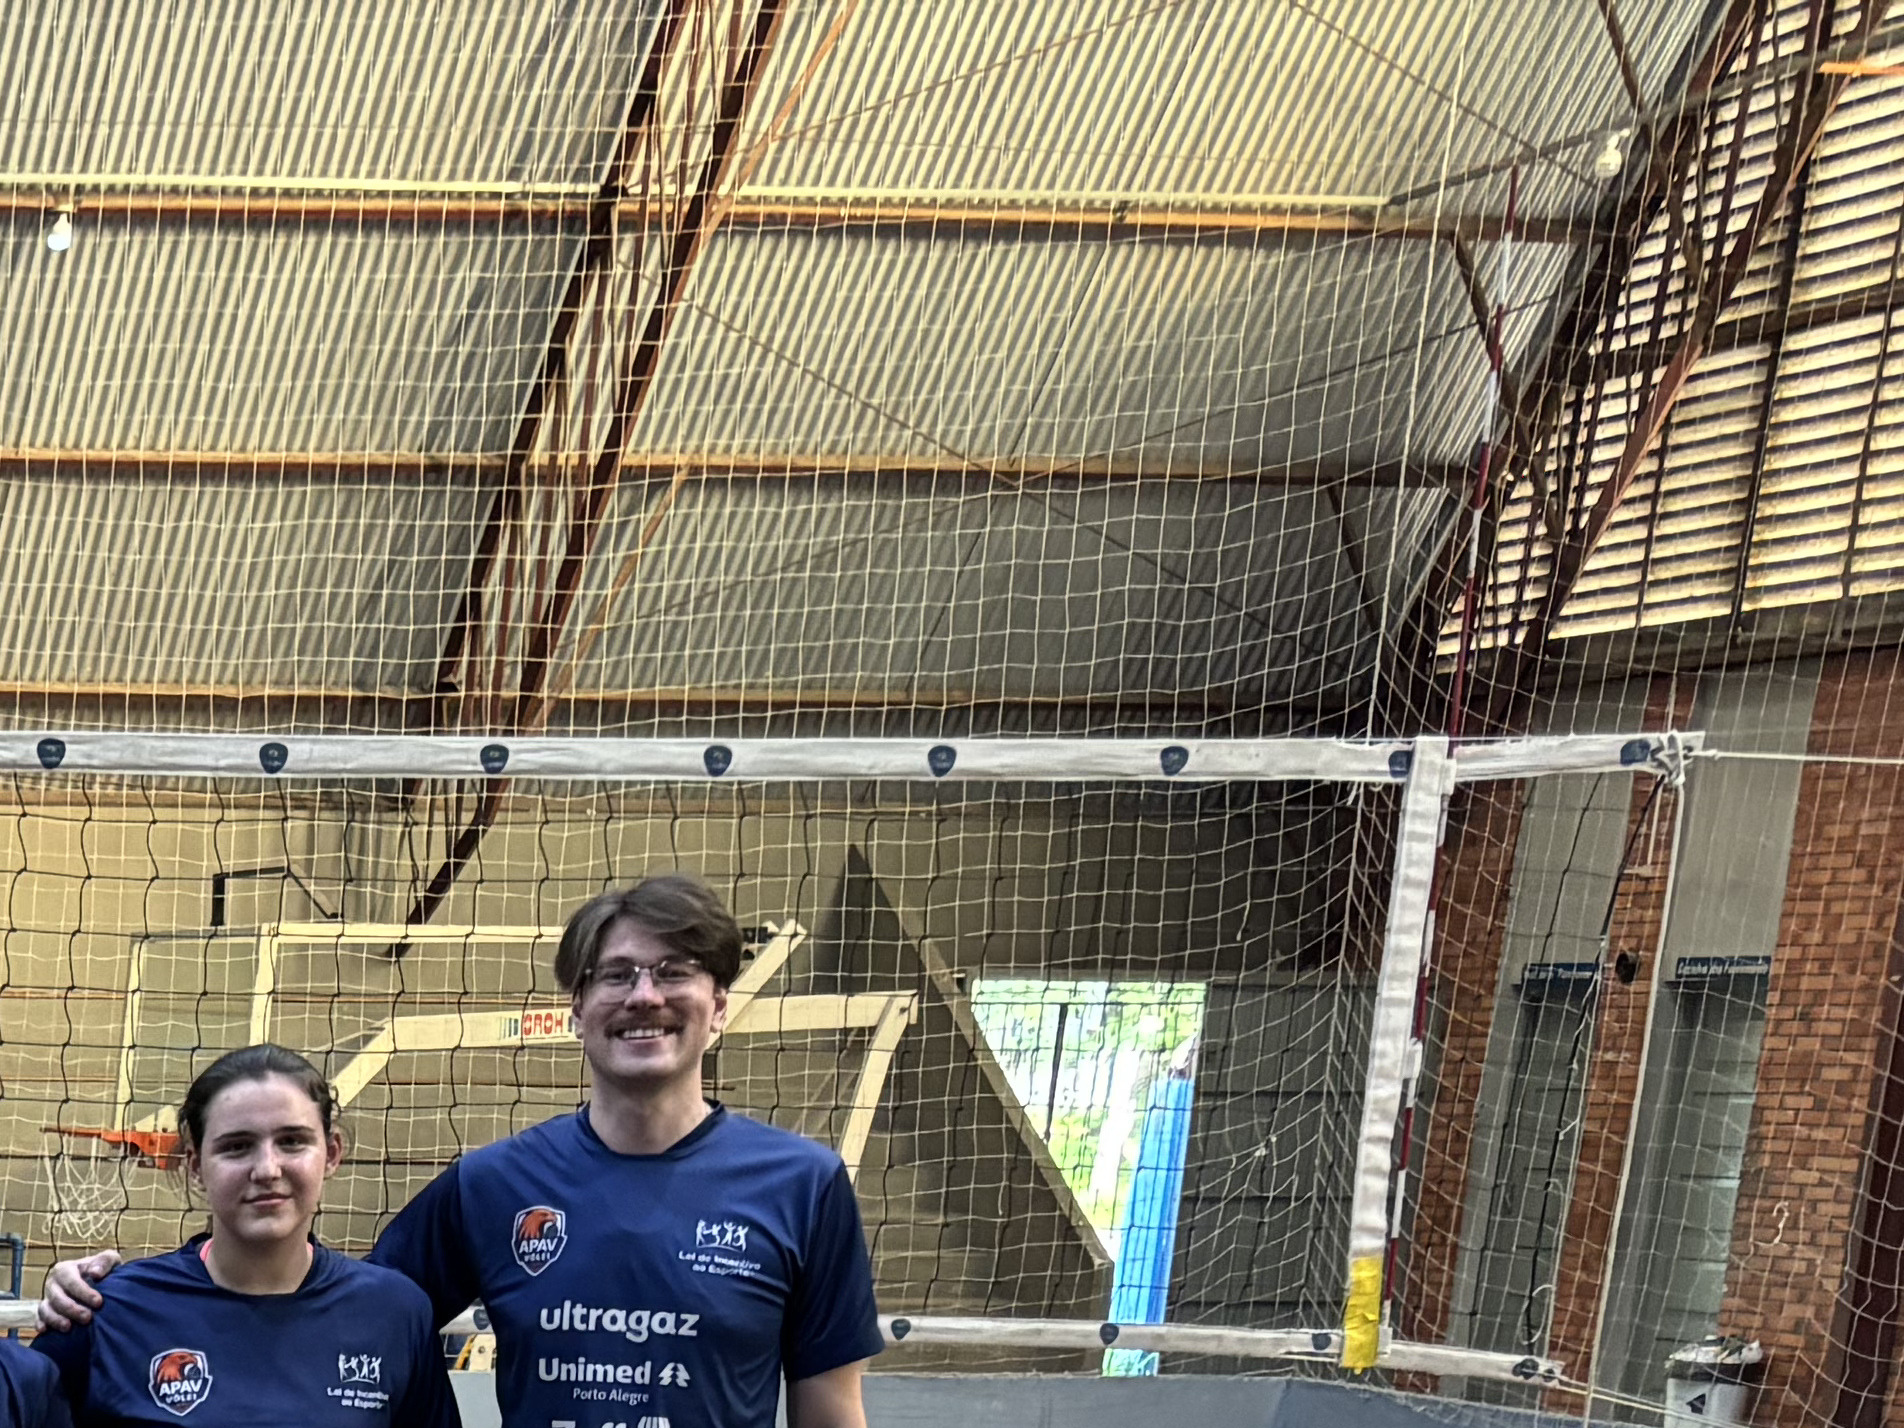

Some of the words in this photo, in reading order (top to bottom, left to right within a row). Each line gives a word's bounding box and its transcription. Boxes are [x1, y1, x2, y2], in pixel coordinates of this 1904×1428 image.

[519, 1238, 557, 1254] APAV
[540, 1300, 700, 1343] ultragaz
[538, 1357, 651, 1386] Unimed
[159, 1379, 202, 1397] APAV
[573, 1388, 606, 1401] Porto
[609, 1390, 649, 1405] Alegre
